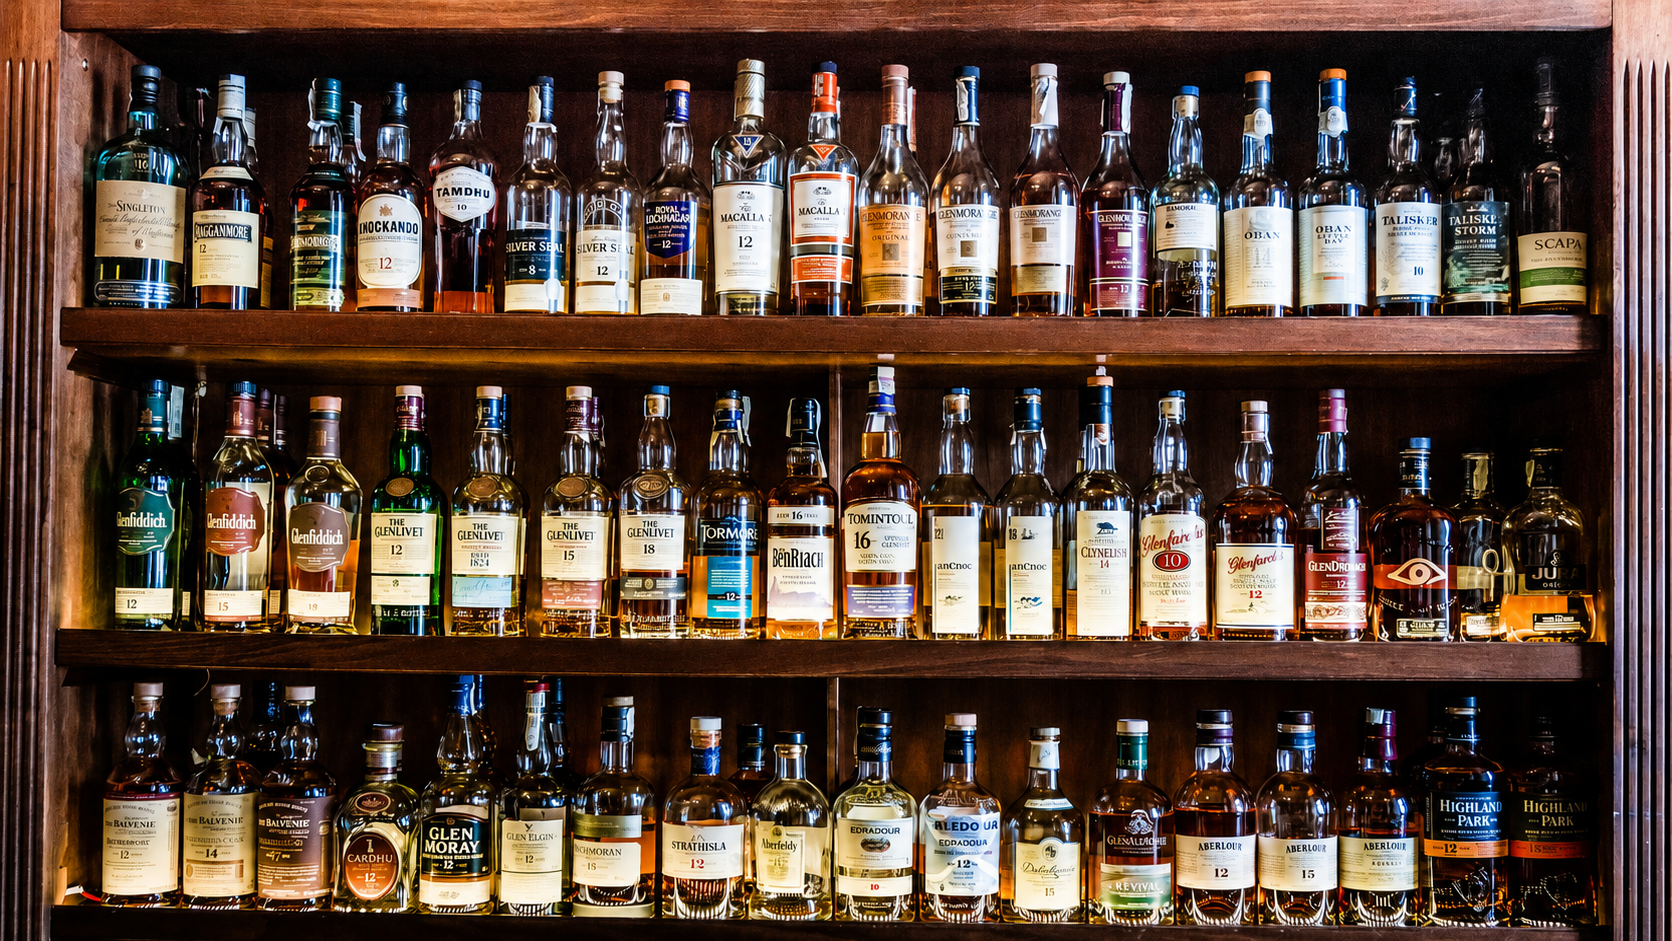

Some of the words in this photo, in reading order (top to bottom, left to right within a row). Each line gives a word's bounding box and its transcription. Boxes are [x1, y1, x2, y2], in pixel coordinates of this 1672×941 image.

[436, 187, 490, 199] TAMDHU
[116, 200, 166, 214] SINGLETON
[457, 203, 468, 211] 10
[1382, 215, 1438, 227] TALISKER
[1244, 231, 1281, 240] OBAN
[1315, 225, 1352, 235] OBAN
[1454, 225, 1497, 236] STORM
[662, 240, 672, 249] 12
[738, 235, 753, 248] 12
[1534, 237, 1583, 251] SCAPA
[505, 241, 537, 254] SILVER
[577, 243, 608, 255] SILVER
[379, 256, 392, 270] 12
[528, 264, 536, 275] 8
[597, 266, 609, 276] 12
[1413, 265, 1424, 276] 10
[206, 512, 257, 530] Glenfiddich
[791, 510, 803, 521] 16
[847, 512, 914, 525] TOMINTOUL
[389, 518, 405, 526] THE
[562, 522, 579, 530] THE
[642, 520, 658, 528] THE
[291, 527, 344, 545] Glenfiddich
[374, 526, 424, 538] GLENLIVET
[457, 530, 505, 541] GLENLIVET
[547, 530, 595, 541] GLENLIVET
[627, 528, 675, 539] GLENLIVET
[701, 524, 759, 543] TORMORE
[854, 530, 871, 550] 16
[391, 544, 403, 555] 12
[643, 544, 655, 555] 18
[1081, 546, 1127, 559] CLYNELISH
[563, 550, 575, 561] 15
[1163, 554, 1182, 568] 10
[937, 562, 972, 570] anCnoc
[1011, 562, 1047, 571] anCnoc
[1100, 560, 1109, 569] 14
[1531, 566, 1580, 580] JURA
[1336, 579, 1346, 589] 12
[726, 592, 736, 601] 12
[1249, 589, 1263, 599] 12
[126, 599, 138, 609] 12
[217, 601, 229, 612] 15
[1439, 799, 1503, 813] HIGHLAND
[1523, 799, 1588, 813] HIGHLAND
[113, 819, 156, 829] BALVENIE
[198, 815, 244, 826] BALVENIE
[266, 818, 311, 828] BALVENIE
[1457, 814, 1491, 827] PARK
[1541, 814, 1575, 827] PARK
[428, 826, 474, 841] GLEN
[506, 832, 527, 841] GLEN
[528, 832, 554, 842] ELGIN
[424, 839, 480, 854] MORAY
[671, 840, 727, 852] STRATHISLA
[761, 838, 798, 853] Aberfeldy
[1198, 841, 1243, 852] ABERLOUR
[1285, 843, 1327, 854] ABERLOUR
[1363, 841, 1407, 852] ABERLOUR
[1443, 843, 1457, 853] 12
[120, 849, 130, 860] 12
[205, 848, 219, 859] 14
[347, 853, 394, 864] CARDHU
[525, 854, 534, 864] 12
[443, 860, 454, 870] 12
[690, 858, 705, 869] 12
[957, 859, 971, 869] 12
[364, 872, 376, 883] 12
[1214, 867, 1229, 878] 12
[1301, 869, 1315, 879] 15
[870, 883, 880, 891] 10
[1045, 887, 1055, 897] 15
[1115, 881, 1160, 892] REVIVAL
